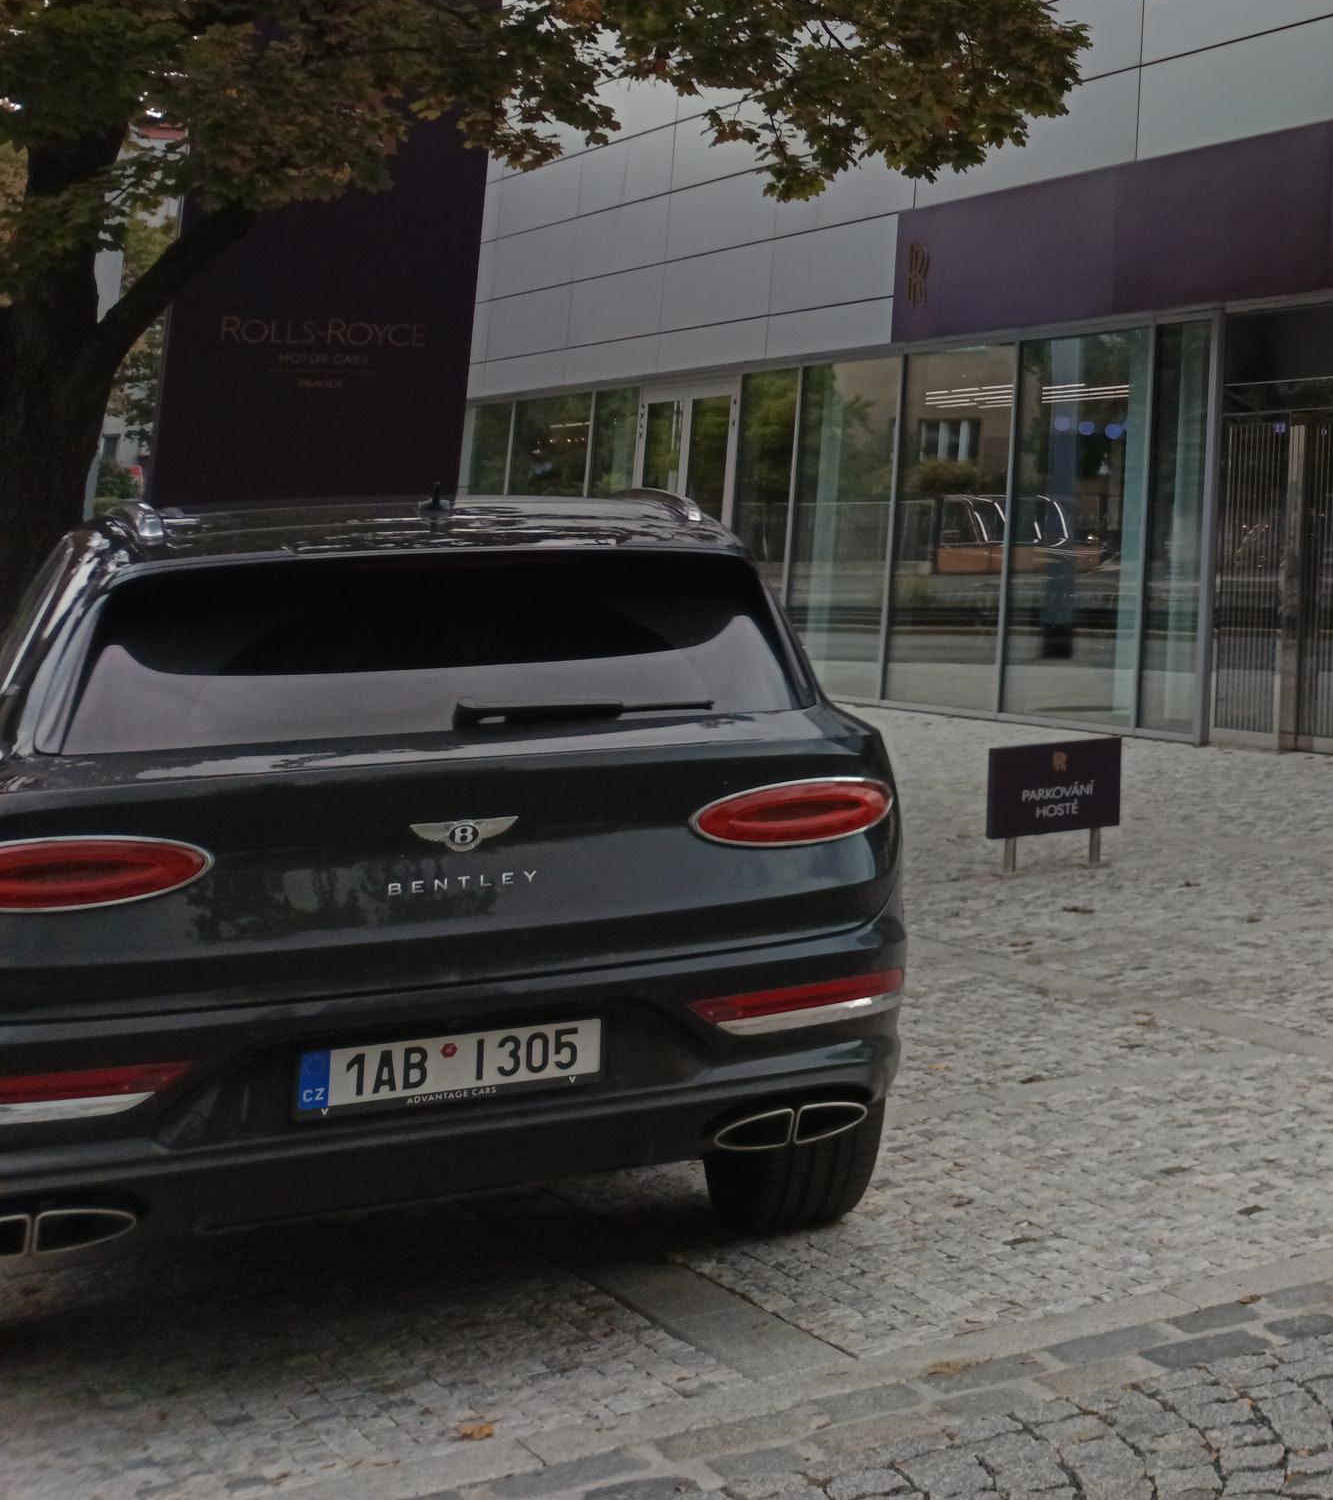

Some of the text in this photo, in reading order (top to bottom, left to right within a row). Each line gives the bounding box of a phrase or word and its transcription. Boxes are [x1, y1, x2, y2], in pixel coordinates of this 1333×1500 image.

[219, 315, 426, 349] ROLLS-ROYCE
[277, 352, 370, 366] MOTOR CARS
[1021, 779, 1095, 803] PARKOVÁNÍ
[1035, 799, 1081, 819] HOSTÉ
[387, 869, 538, 897] BENTLEY
[302, 1086, 325, 1103] CZ
[345, 1045, 430, 1097] 1AB
[406, 1085, 498, 1106] ADVANTAGE CARS
